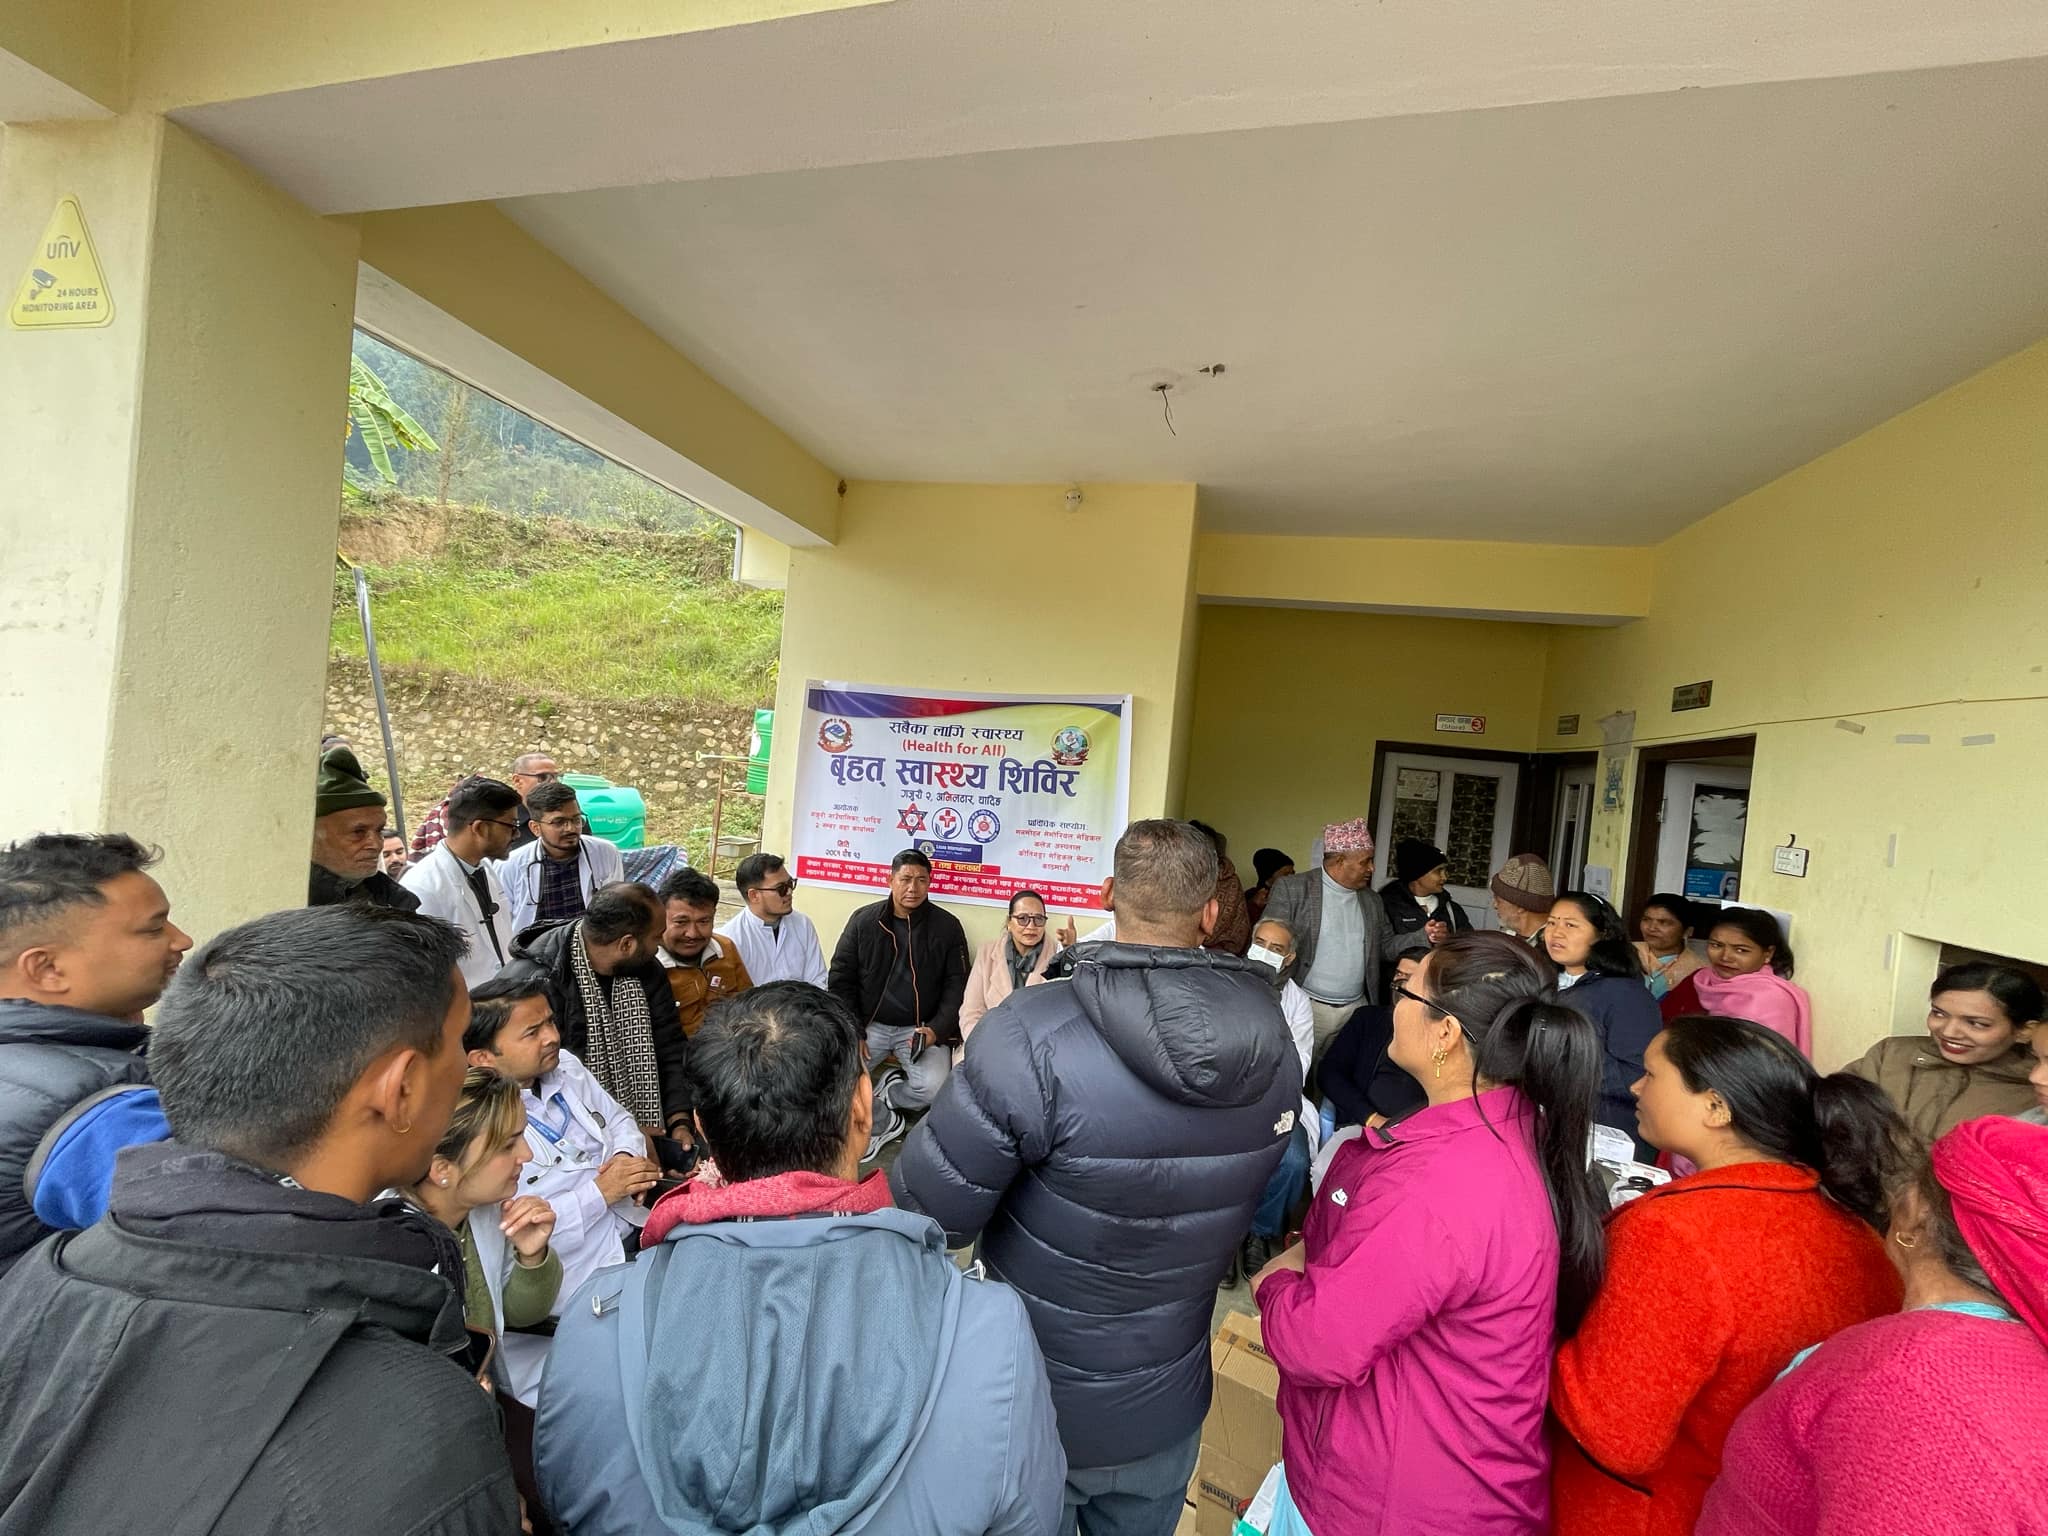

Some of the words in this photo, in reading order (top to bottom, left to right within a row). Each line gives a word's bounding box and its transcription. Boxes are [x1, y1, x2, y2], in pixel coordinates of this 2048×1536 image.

[57, 289, 67, 297] 24
[69, 288, 98, 297] HOURS
[22, 303, 73, 312] MONITORING
[75, 301, 97, 310] AREA
[889, 720, 928, 735] सबैका
[933, 725, 965, 738] लागि
[972, 728, 1024, 741] स्वास्थ्य
[903, 739, 953, 753] (Health
[957, 743, 978, 754] for
[981, 744, 1006, 758] All)
[831, 754, 886, 787] बृहत्
[896, 759, 989, 789] स्वास्थ्य
[999, 757, 1080, 797] शिविर
